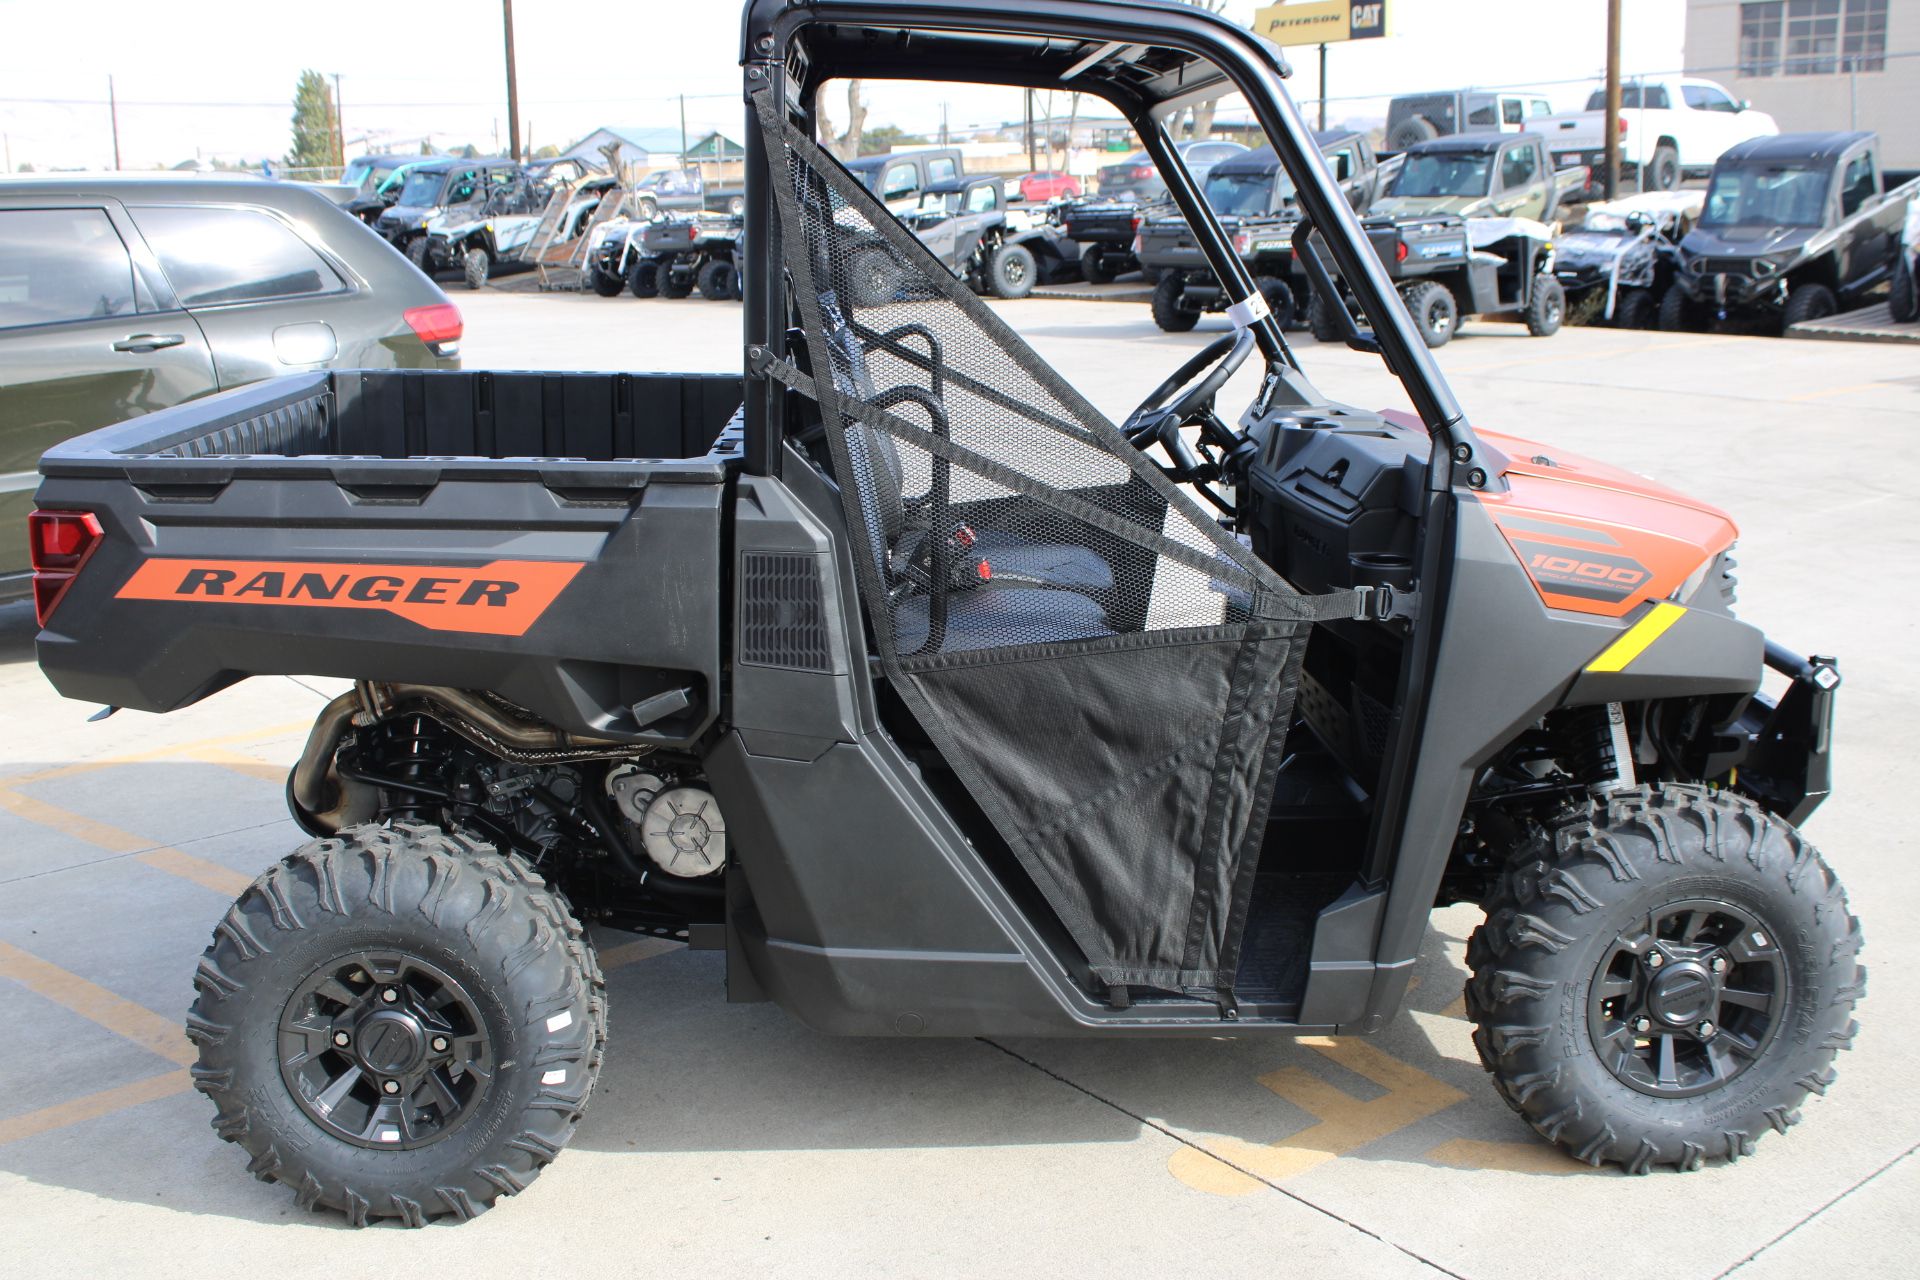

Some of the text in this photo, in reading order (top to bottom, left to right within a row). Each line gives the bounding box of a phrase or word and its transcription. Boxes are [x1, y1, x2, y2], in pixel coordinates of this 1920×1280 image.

[1269, 14, 1341, 33] PETERSON
[1351, 4, 1382, 29] CAT
[1530, 553, 1645, 584] 1000
[175, 568, 520, 607] RANGER
